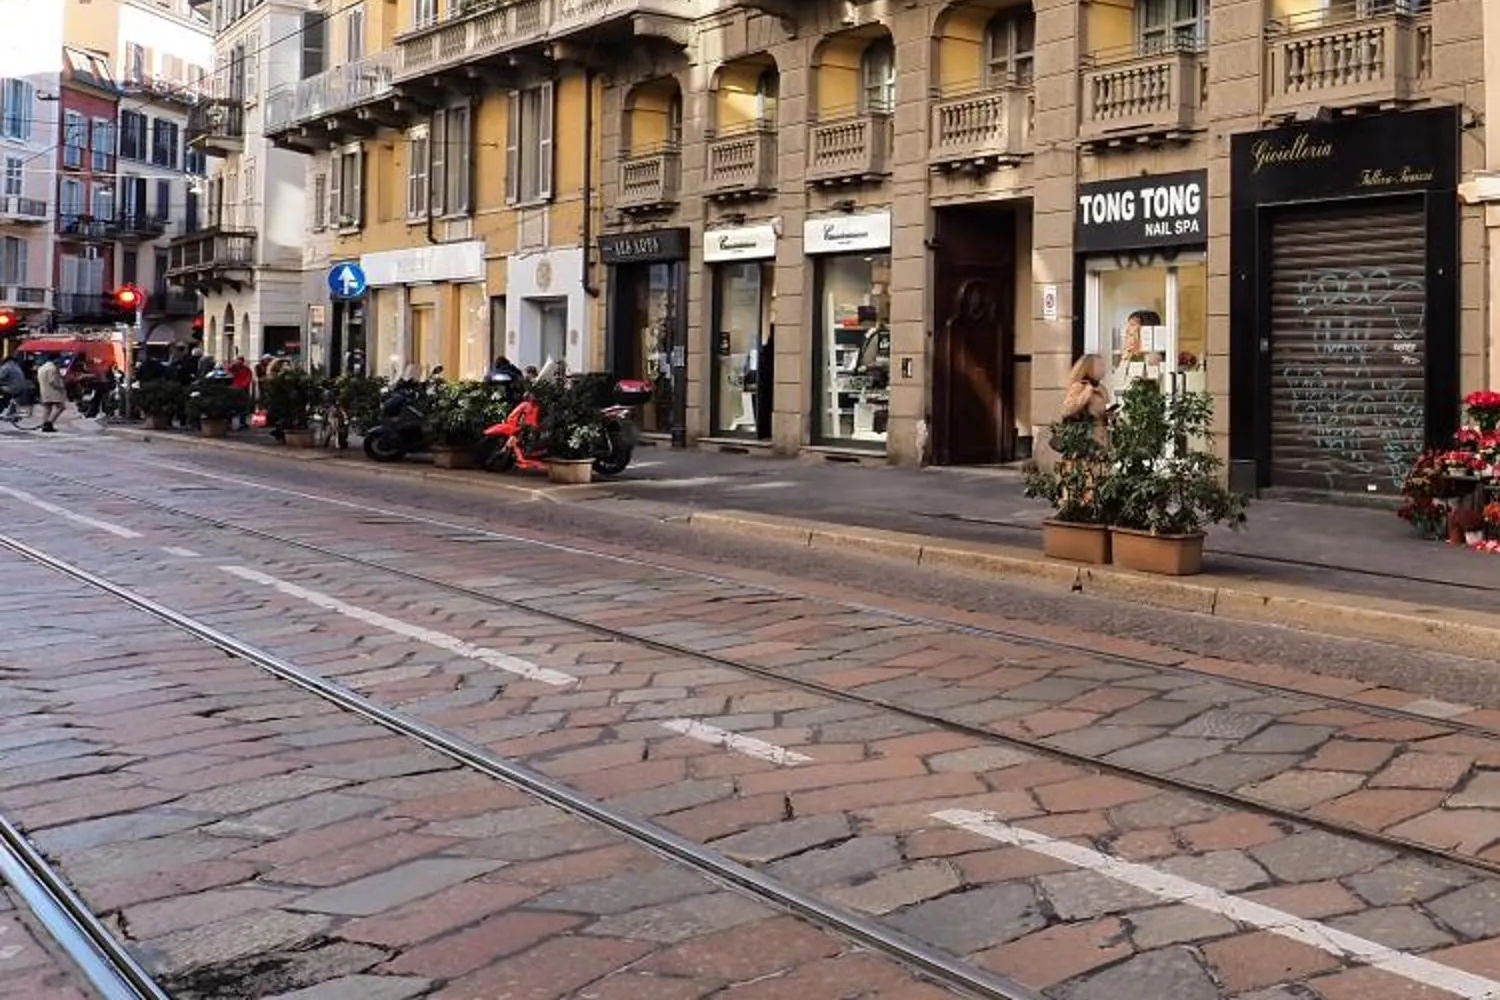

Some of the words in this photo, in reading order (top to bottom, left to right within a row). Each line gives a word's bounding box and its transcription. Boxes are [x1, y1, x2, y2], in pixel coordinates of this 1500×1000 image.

[1251, 132, 1334, 174] Gioielleria
[1079, 190, 1135, 225] TONG
[1140, 183, 1201, 219] TONG
[1145, 221, 1172, 237] NAIL
[1175, 219, 1200, 235] SPA
